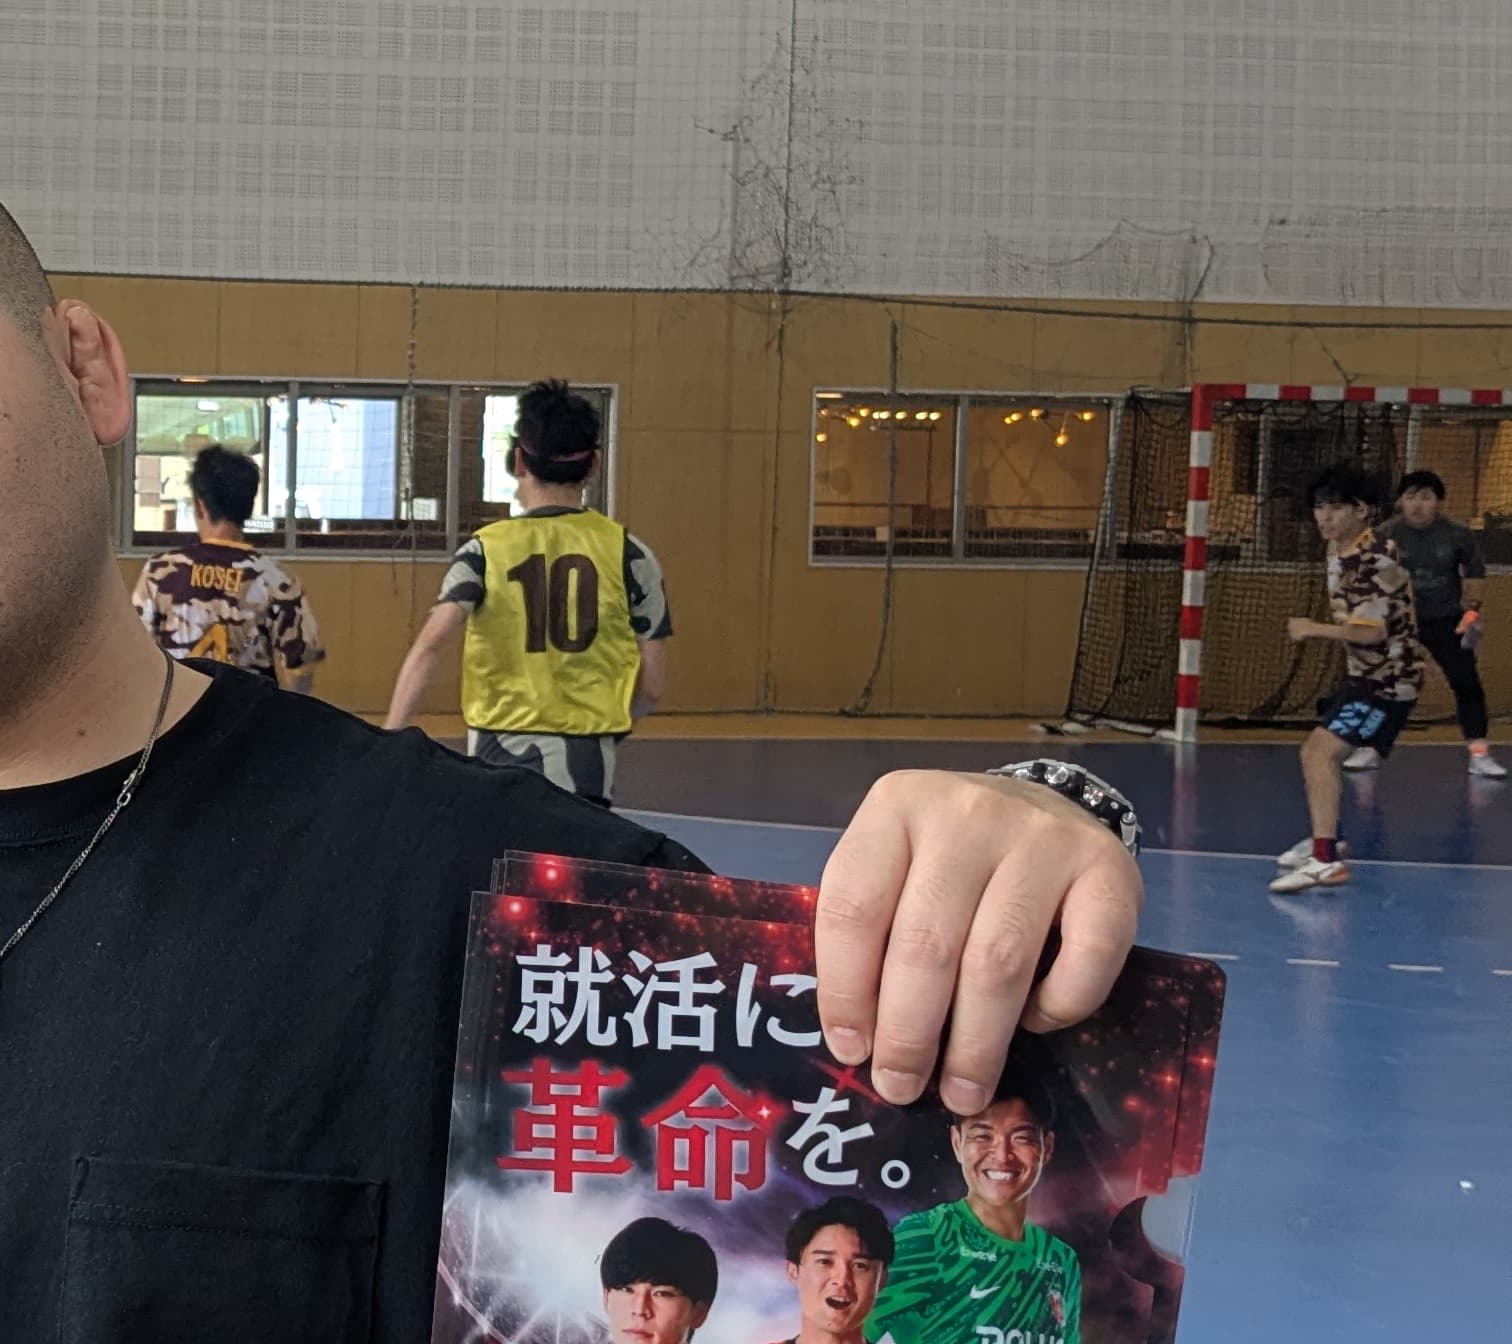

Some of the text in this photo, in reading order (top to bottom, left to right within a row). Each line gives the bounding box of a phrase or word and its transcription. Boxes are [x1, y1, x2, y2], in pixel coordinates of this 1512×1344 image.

[190, 563, 244, 593] KOSEI
[507, 553, 599, 654] 10
[511, 943, 822, 1053] 就活に
[496, 1057, 911, 1202] 革命を。
